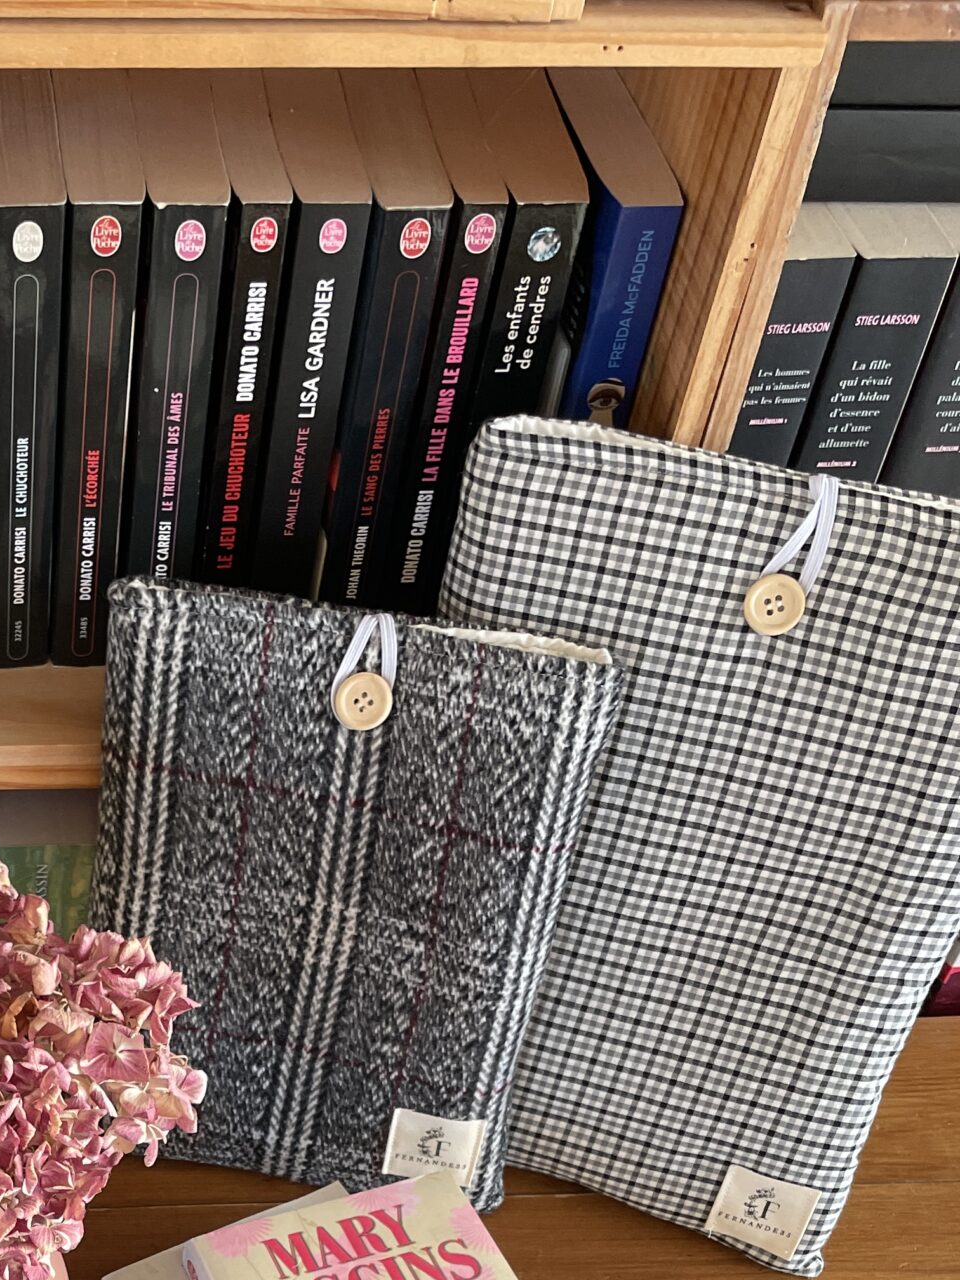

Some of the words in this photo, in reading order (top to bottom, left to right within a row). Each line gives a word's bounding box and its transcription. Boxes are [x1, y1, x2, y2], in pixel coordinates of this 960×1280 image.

[243, 282, 267, 341] CARRISI
[305, 278, 335, 371] GARDNER
[446, 277, 479, 364] BROUILLARD
[495, 343, 515, 374] Les
[507, 275, 531, 341] enfants
[515, 348, 533, 370] de
[526, 274, 552, 345] cendres
[767, 323, 791, 335] STIEG
[792, 322, 830, 333] LARSSON
[855, 315, 879, 326] STIEG
[880, 314, 920, 326] LARSSON
[608, 317, 632, 368] FREIDA
[236, 345, 259, 402] DONATO
[442, 368, 460, 384] LE
[758, 369, 773, 378] Les
[775, 368, 810, 377] hommes
[839, 377, 858, 389] qui
[860, 375, 892, 386] rêvait
[851, 361, 867, 371] La
[869, 360, 891, 370] fille
[298, 377, 320, 419] LISA
[434, 388, 456, 424] DANS
[743, 398, 758, 408] pas
[760, 396, 773, 405] les
[774, 395, 807, 405] femmes
[748, 384, 764, 394] qui
[830, 393, 855, 403] d'un
[858, 391, 890, 401] bidon
[166, 392, 183, 424] ÂMES
[829, 408, 880, 418] d'essence
[167, 426, 180, 445] DES
[371, 408, 390, 451] PIERRES
[818, 439, 869, 449] allumette
[827, 424, 838, 433] et
[840, 422, 871, 433] d'une
[225, 413, 250, 501] CHUCHOTEUR
[291, 427, 310, 486] PARFAITE
[426, 428, 447, 462] FILLE
[15, 437, 29, 504] CHUCHOTEUR
[163, 448, 178, 498] TRIBUNAL
[369, 453, 383, 472] DES
[421, 466, 439, 482] LA
[363, 474, 378, 504] SANG
[15, 507, 27, 518] LE
[161, 501, 173, 512] LE
[222, 505, 239, 522] DU
[284, 489, 301, 536] FAMILLE
[360, 505, 371, 516] LE
[411, 490, 434, 537] CARRISI
[14, 527, 26, 565] CARRISI
[82, 517, 96, 558] CARRISI
[156, 521, 172, 561] CARRISI
[219, 526, 236, 550] JEU
[352, 526, 369, 566] THEORIN
[217, 554, 232, 569] LE
[401, 539, 424, 583] DONATO
[13, 567, 25, 605] DONATO
[79, 560, 93, 601] DONATO
[346, 569, 361, 599] JOHAN
[262, 1204, 416, 1280] MARY
